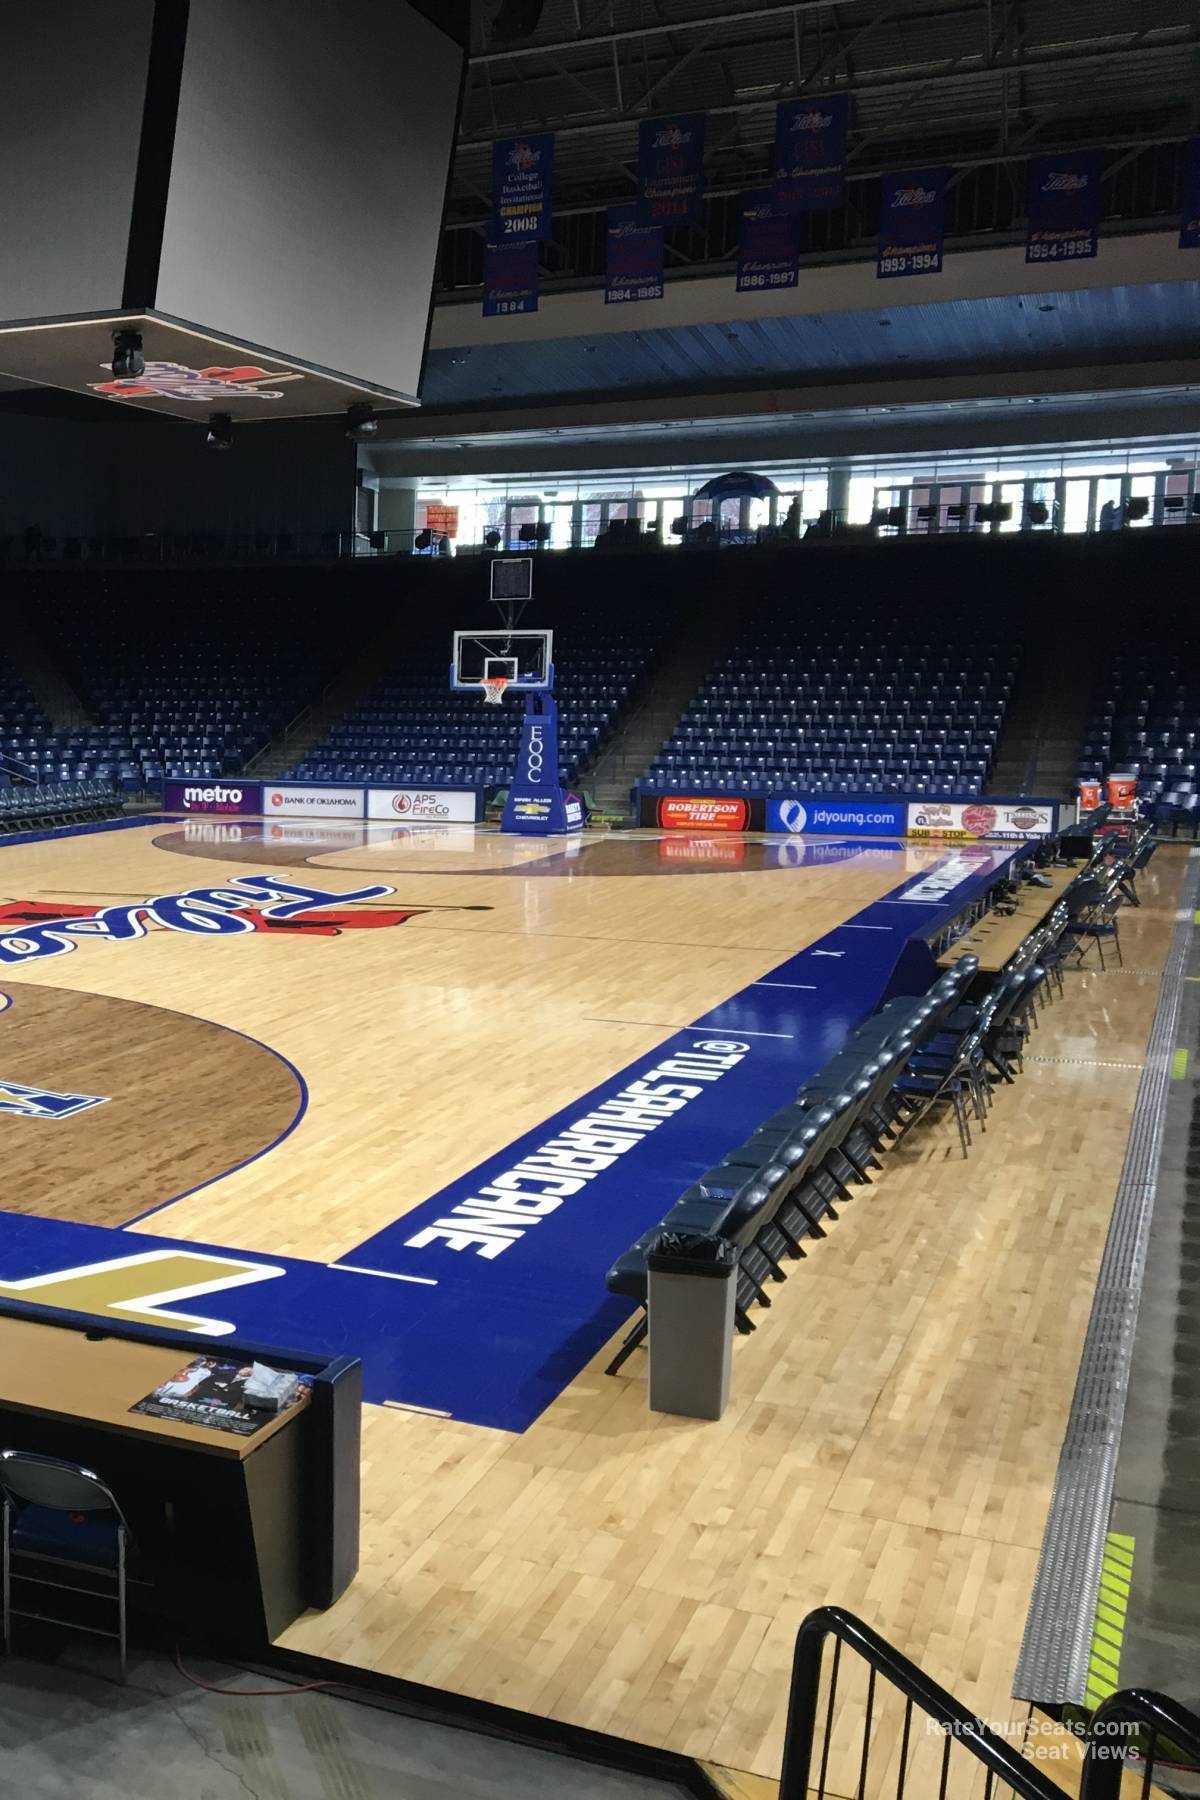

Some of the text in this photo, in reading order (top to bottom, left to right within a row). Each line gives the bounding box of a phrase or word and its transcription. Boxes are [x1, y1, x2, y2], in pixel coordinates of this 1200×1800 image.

[503, 216, 538, 233] 2008
[1029, 239, 1092, 258] 1994-1995
[880, 254, 939, 273] 1993-1994
[740, 271, 795, 287] 1986-1987
[607, 286, 662, 300] 1984-1985
[183, 785, 243, 805] metro
[413, 794, 437, 804] APS
[413, 804, 450, 815] FireCo
[667, 803, 738, 813] ROBERTSON
[688, 812, 717, 821] TIRE
[813, 809, 895, 826] jdyoung.com
[911, 829, 930, 837] SUB
[404, 1040, 751, 1260] @TULSAHURRICANE
[158, 1397, 251, 1420] BASKETBALL
